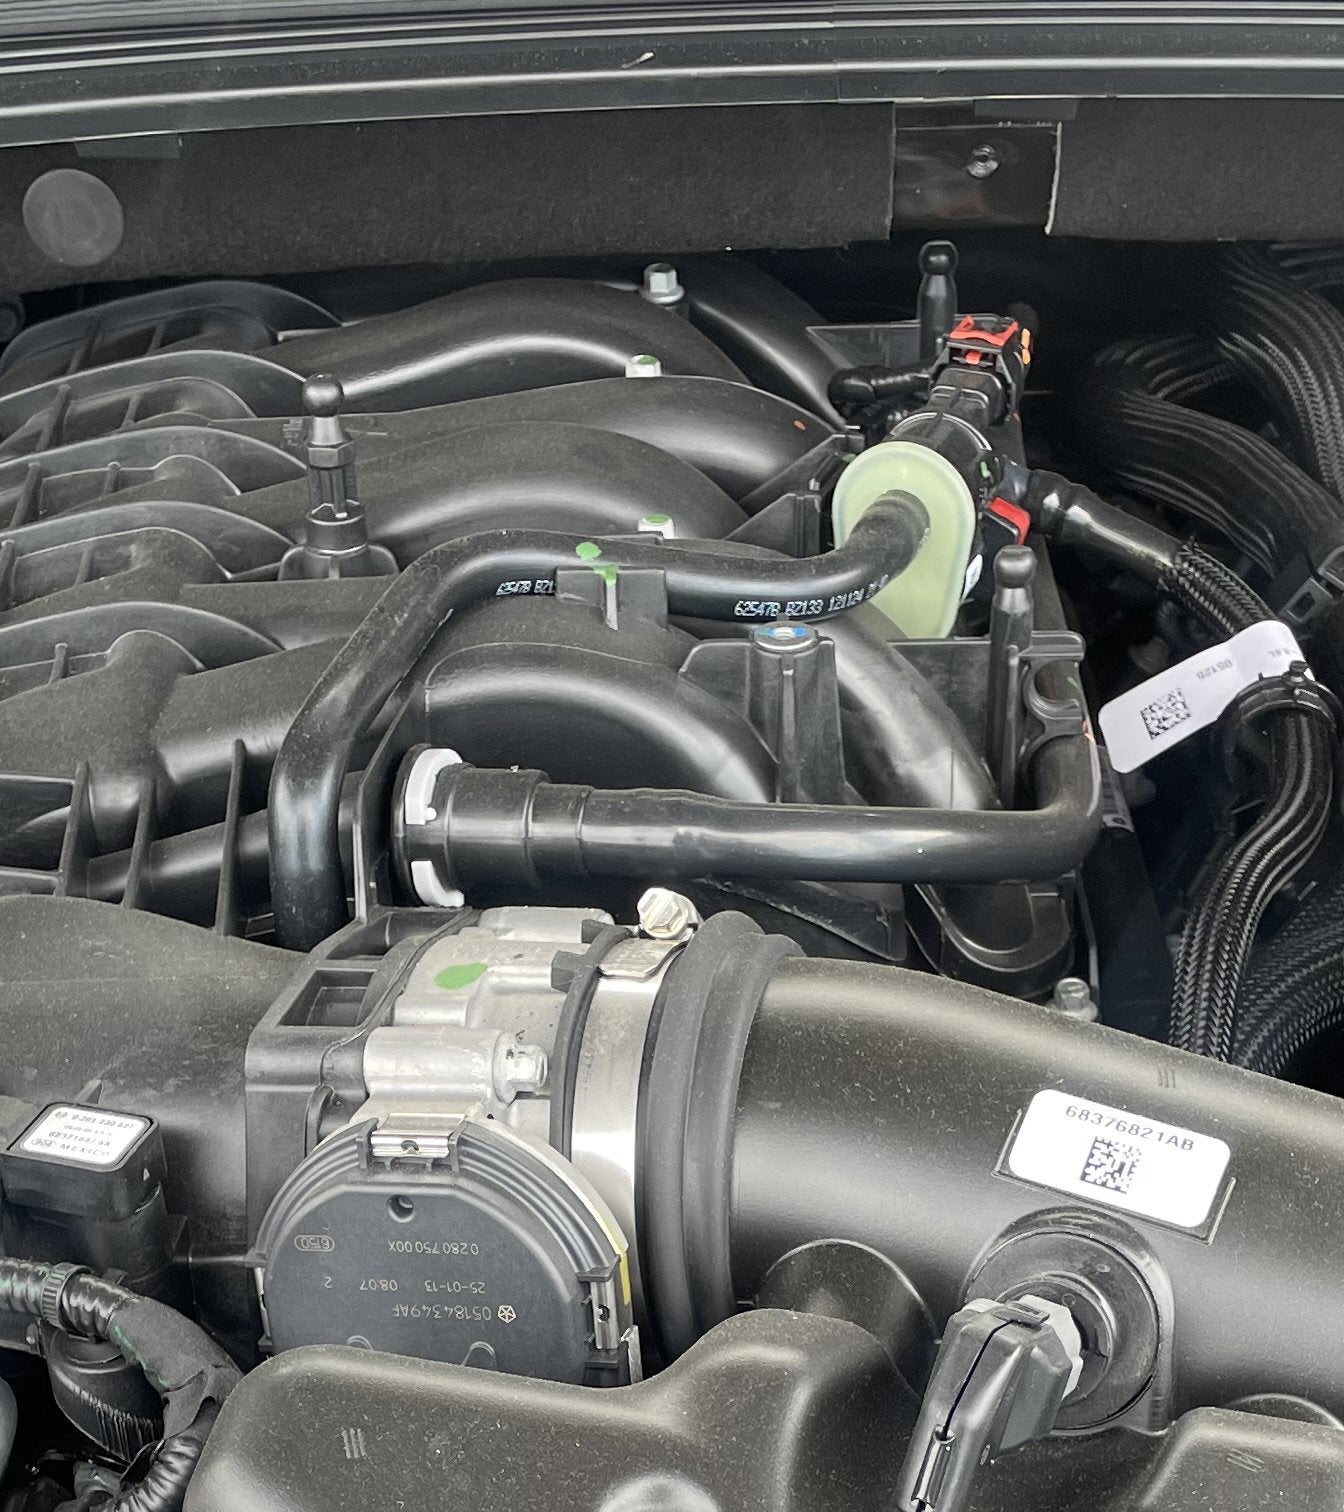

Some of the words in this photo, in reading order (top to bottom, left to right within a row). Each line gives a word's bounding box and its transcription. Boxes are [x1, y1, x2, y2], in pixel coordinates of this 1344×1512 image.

[1065, 1104, 1195, 1151] 68376821AB
[59, 1143, 110, 1156] MEXICO
[424, 1279, 486, 1294] 25-01-13
